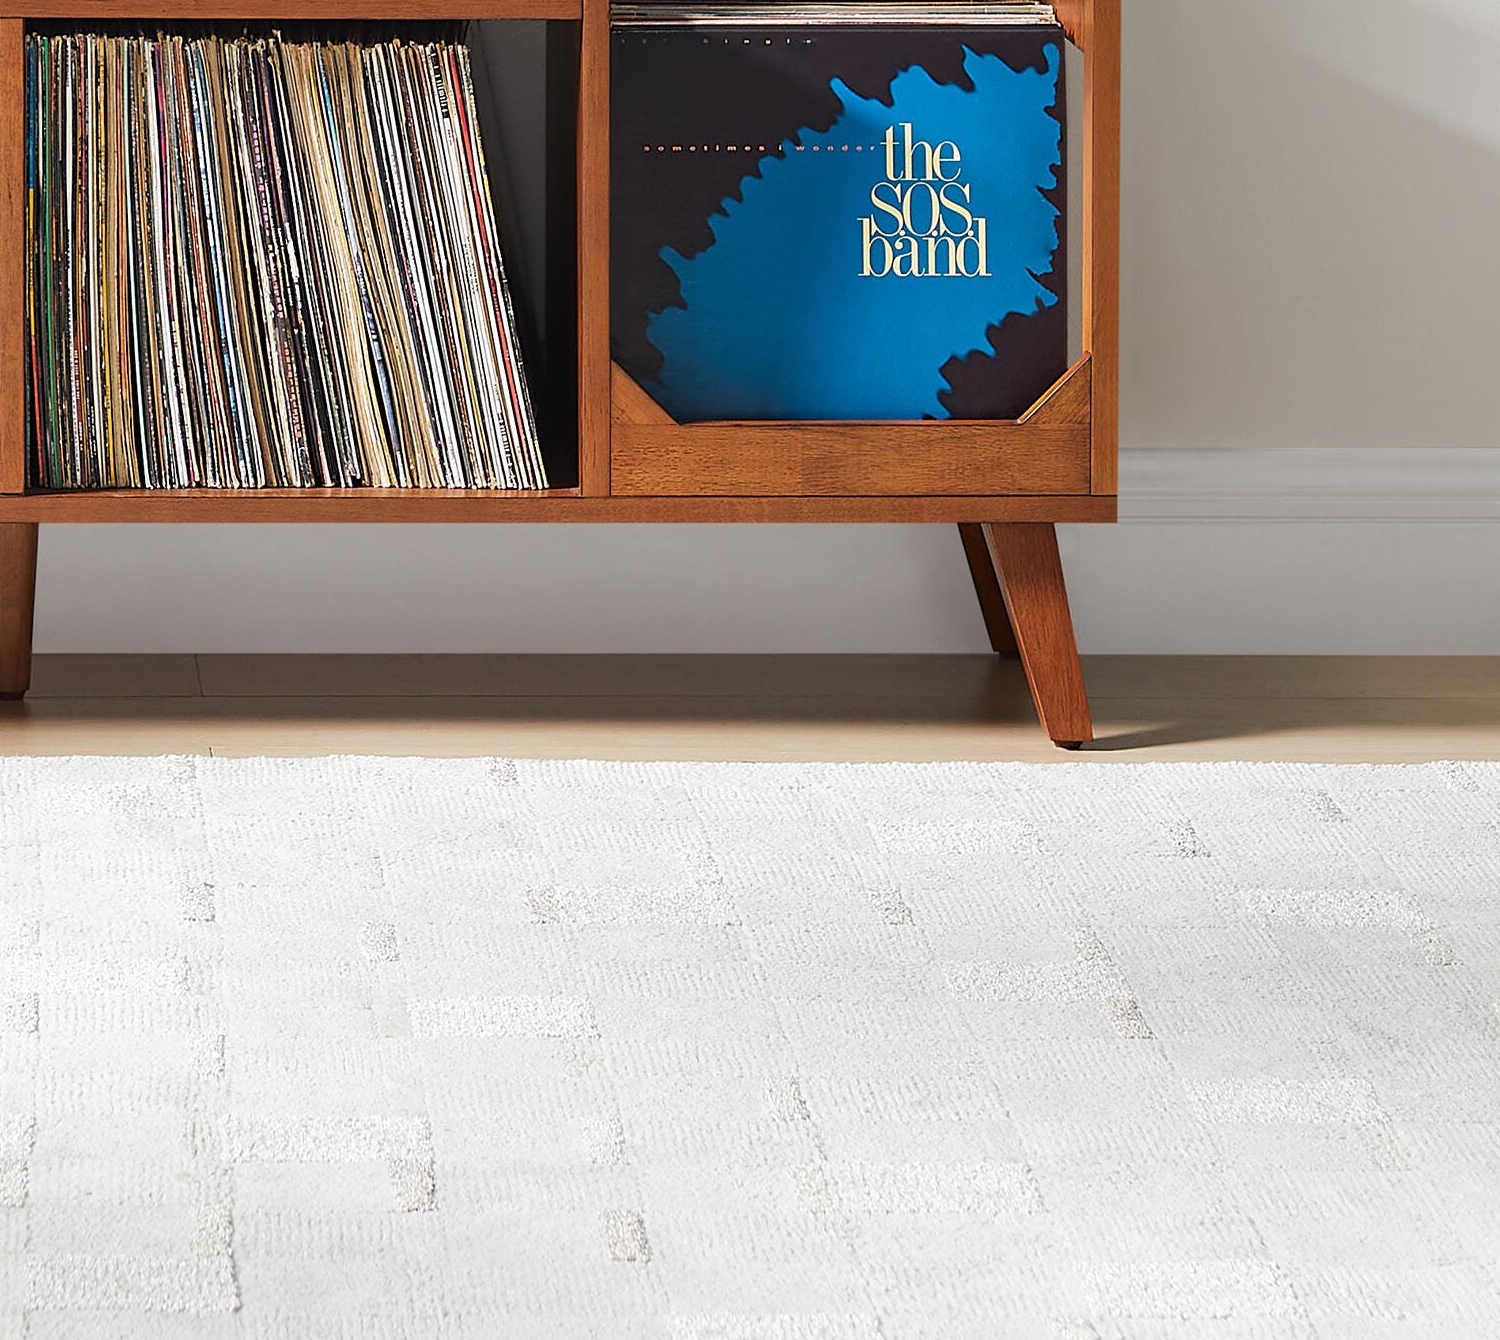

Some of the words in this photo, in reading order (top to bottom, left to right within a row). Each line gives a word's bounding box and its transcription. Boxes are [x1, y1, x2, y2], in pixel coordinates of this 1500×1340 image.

[643, 144, 765, 152] sometimes
[795, 144, 875, 152] wonder
[880, 122, 961, 181] the
[856, 217, 993, 277] band
